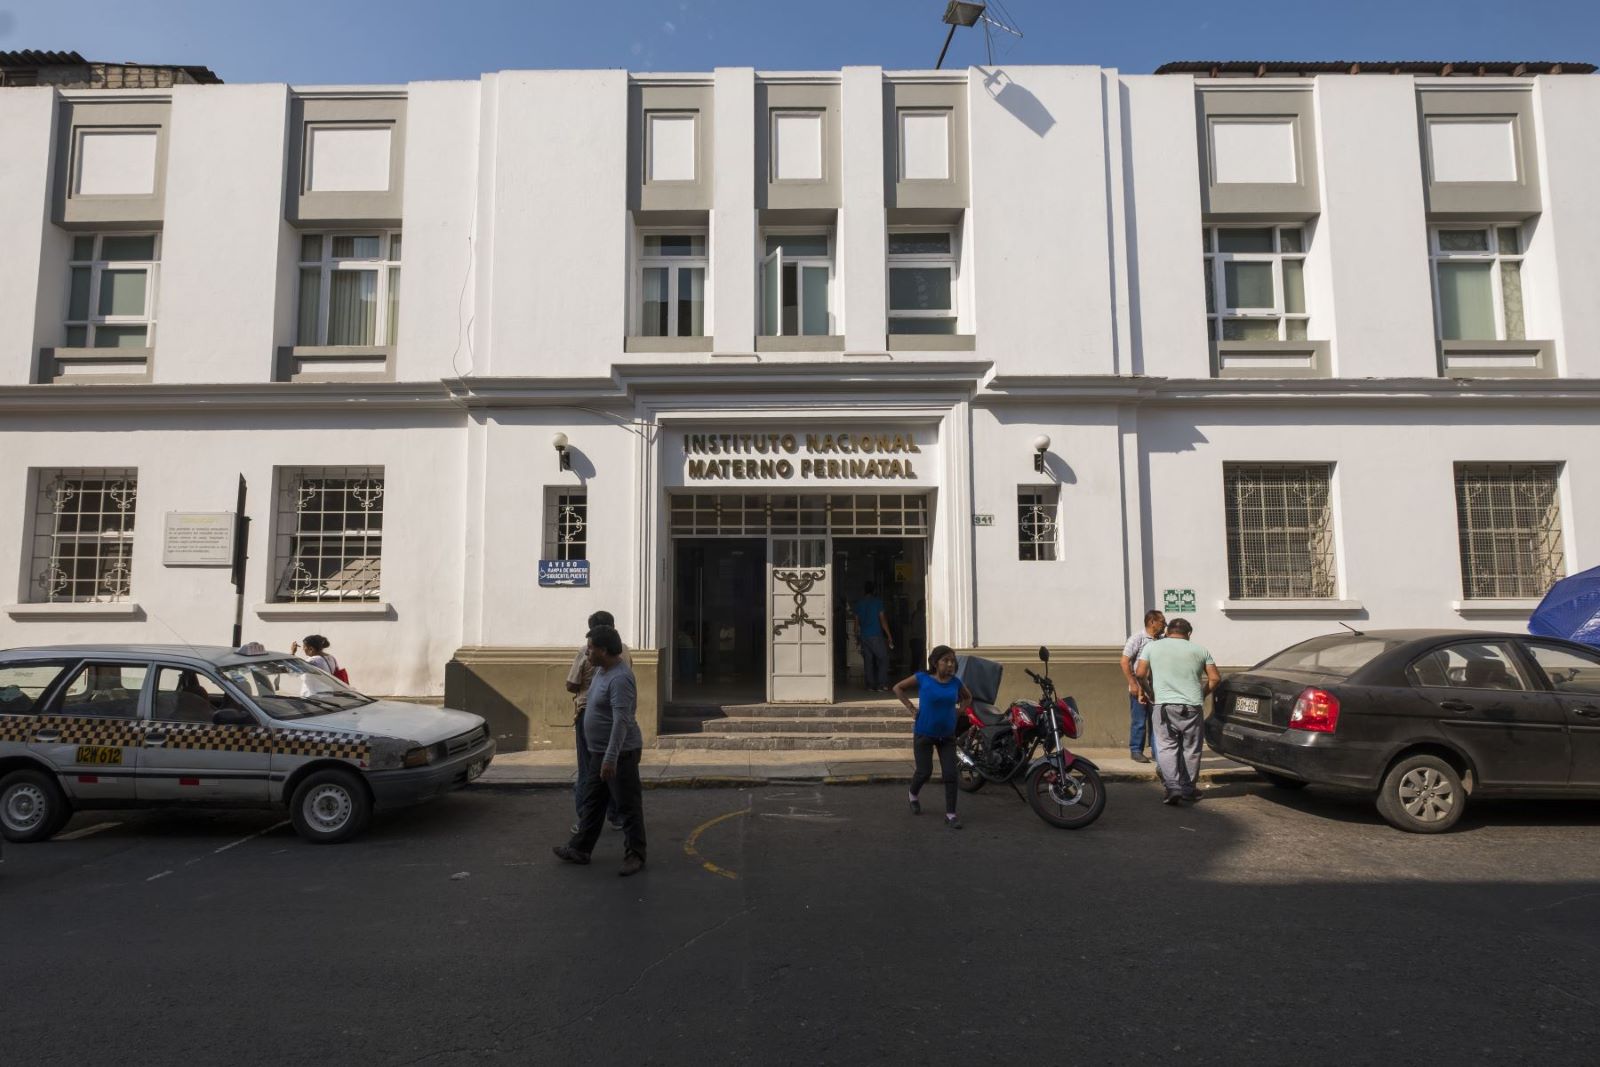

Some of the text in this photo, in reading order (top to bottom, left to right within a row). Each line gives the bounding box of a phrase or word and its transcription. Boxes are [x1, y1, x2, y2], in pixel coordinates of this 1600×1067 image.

[684, 433, 920, 454] INSTITUTO NACIONAL
[688, 459, 917, 479] MATERNO PERINATAL
[100, 746, 121, 764] 612
